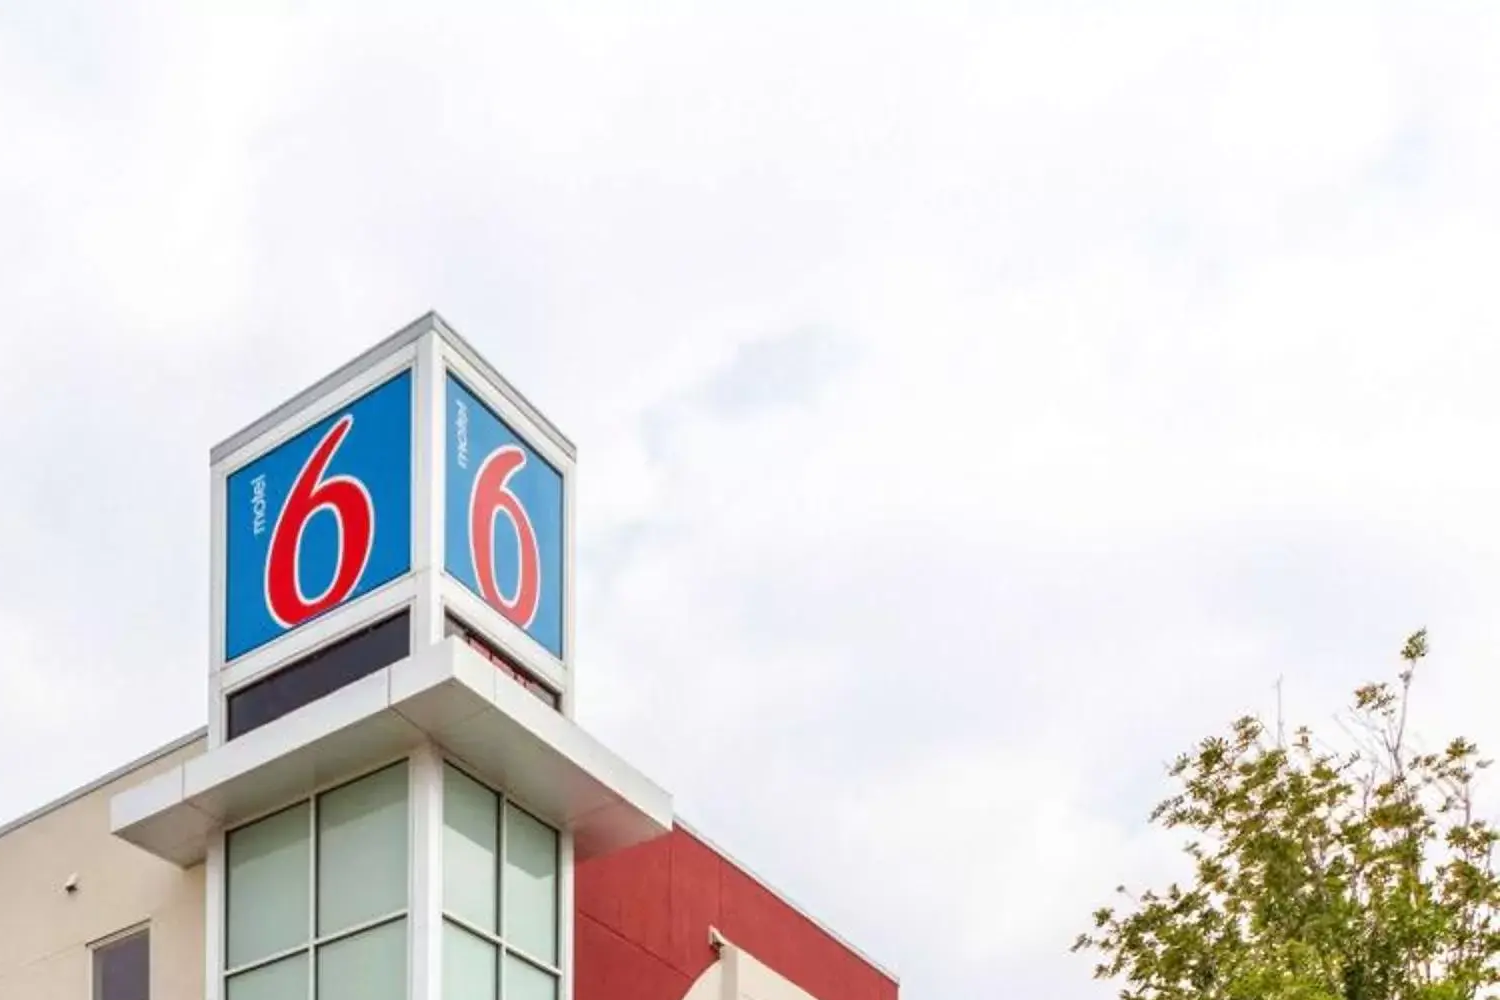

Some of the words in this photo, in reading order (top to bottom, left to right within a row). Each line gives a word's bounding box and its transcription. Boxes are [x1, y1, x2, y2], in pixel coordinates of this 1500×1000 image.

[250, 474, 267, 535] motel
[265, 414, 375, 629] 6
[469, 445, 540, 629] 6
